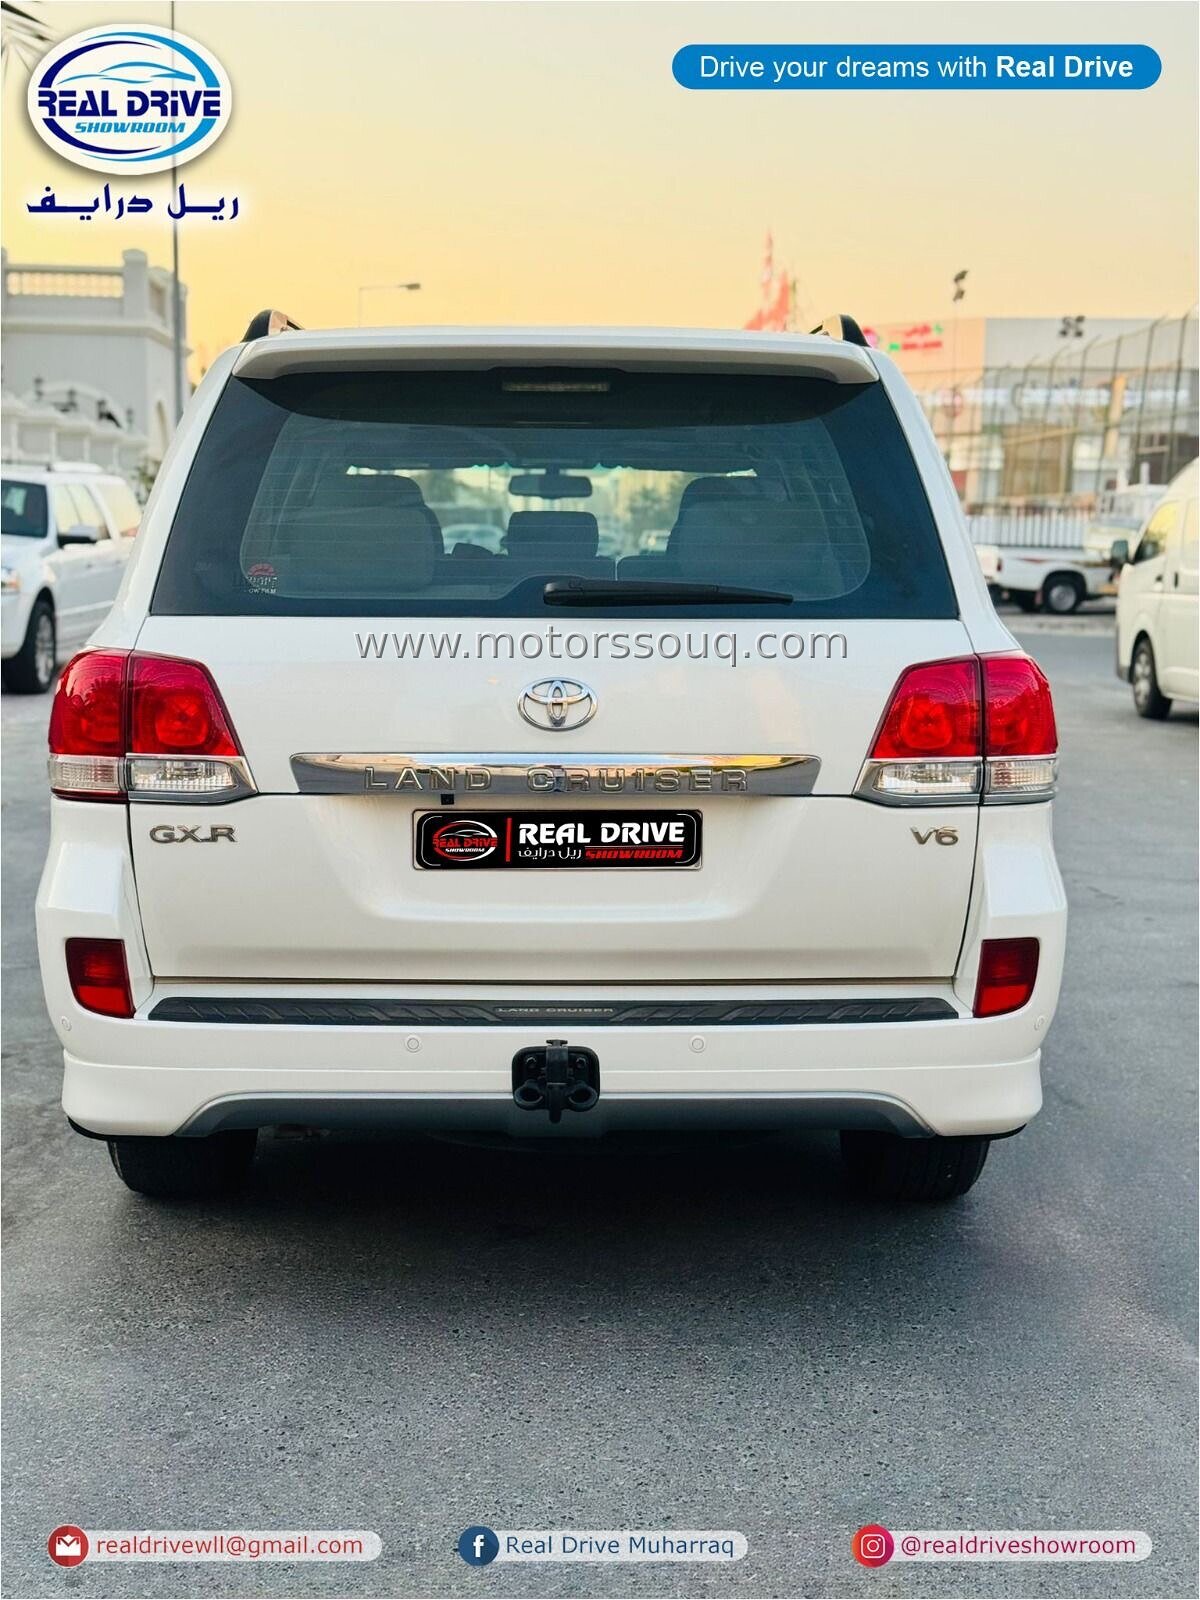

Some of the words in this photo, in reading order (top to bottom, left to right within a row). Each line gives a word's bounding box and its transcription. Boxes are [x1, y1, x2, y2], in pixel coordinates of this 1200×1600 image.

[363, 767, 492, 792] LAND
[526, 767, 750, 793] CRUISER
[910, 826, 959, 846] V6
